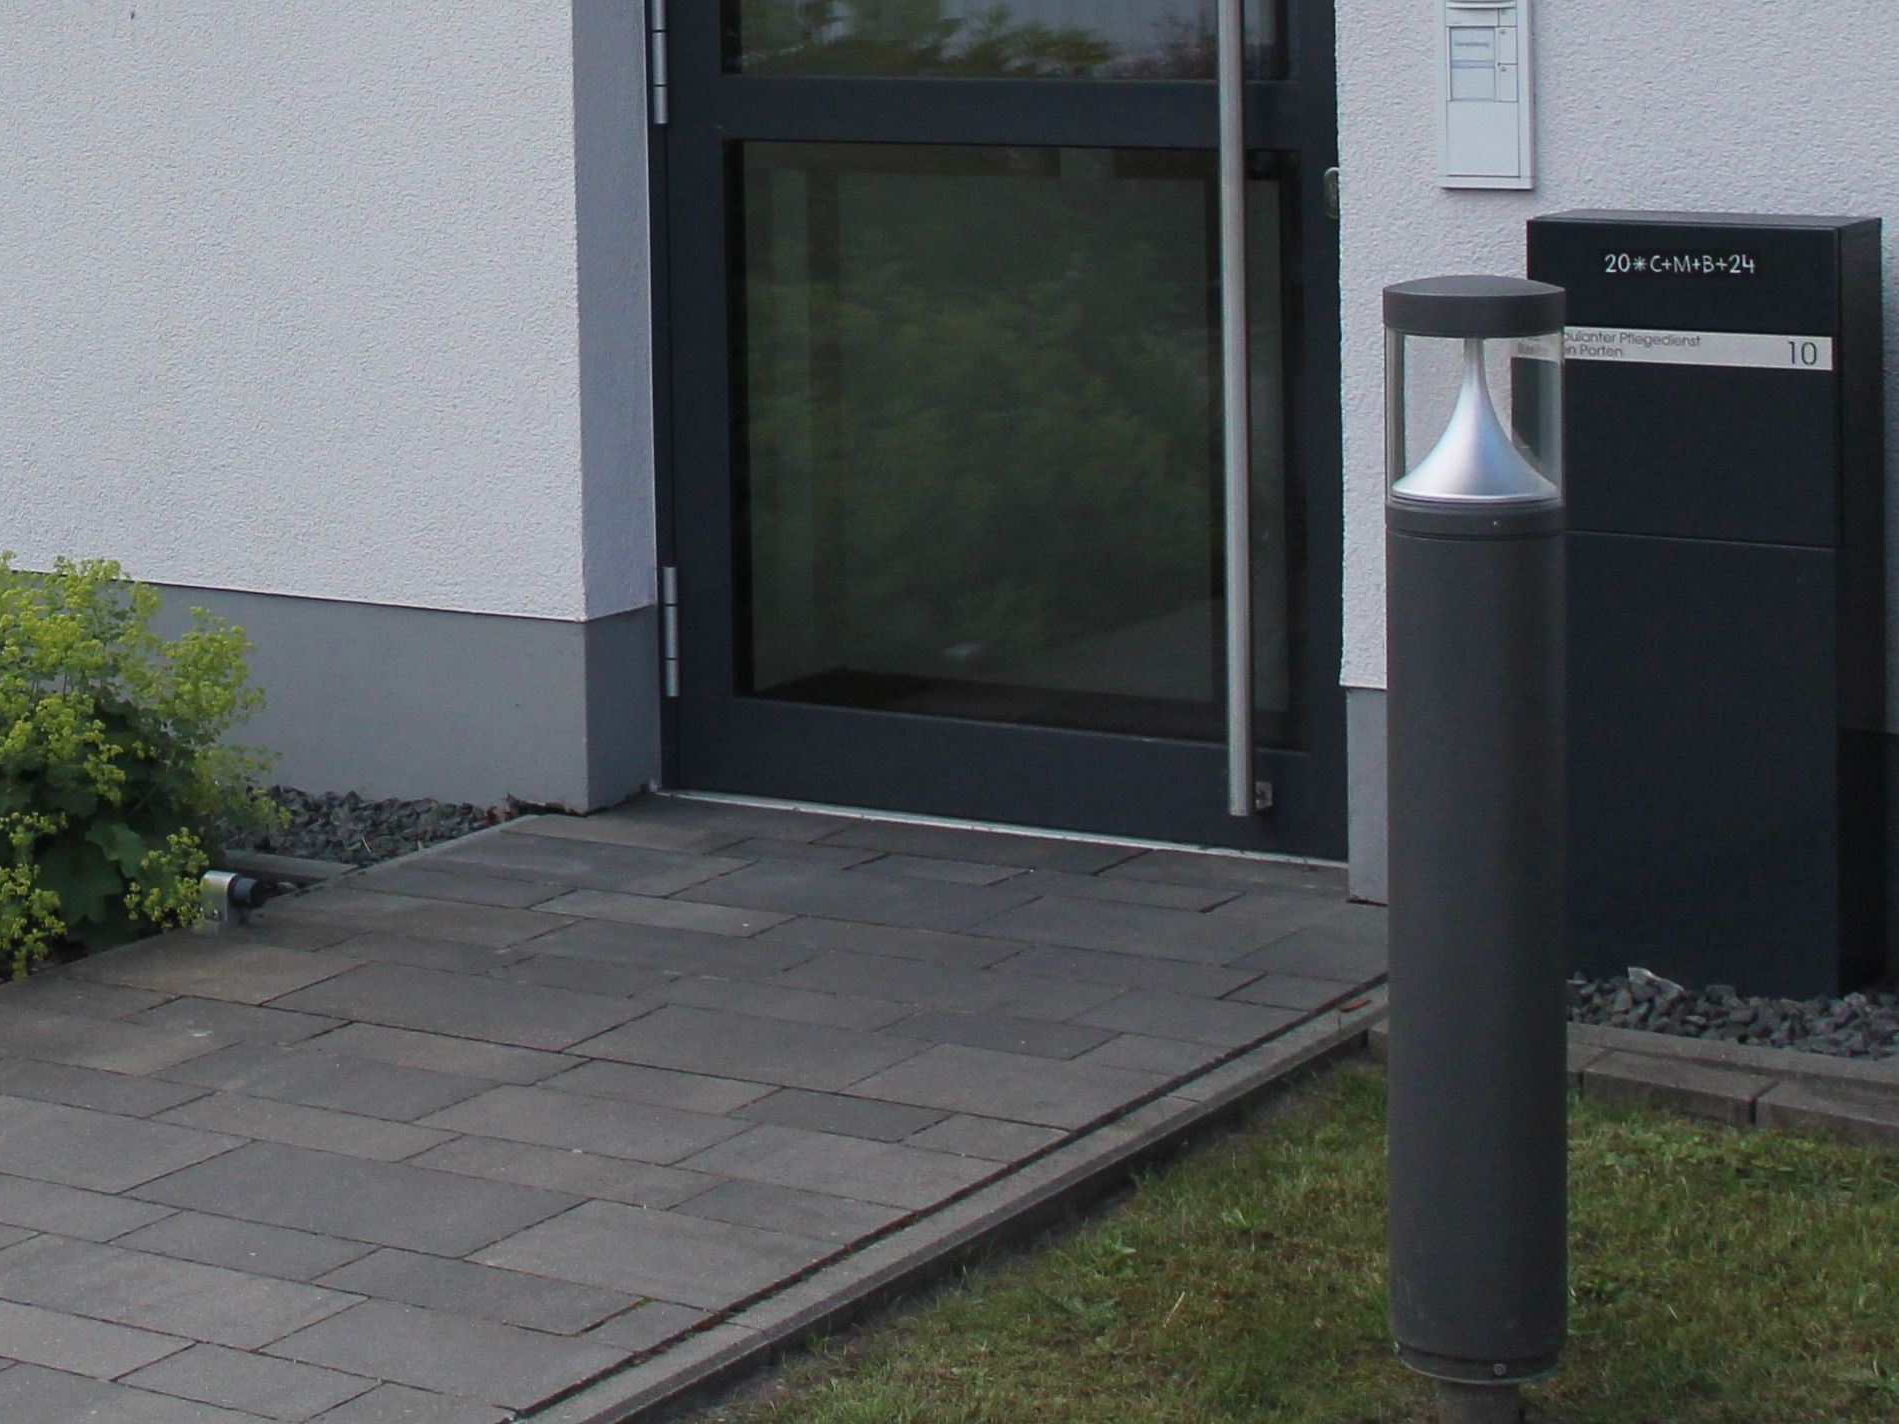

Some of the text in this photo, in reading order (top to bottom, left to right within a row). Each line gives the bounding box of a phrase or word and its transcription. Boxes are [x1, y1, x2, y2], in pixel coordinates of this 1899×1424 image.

[1619, 332, 1702, 348] Pflegedienst
[1580, 344, 1623, 358] Porten
[1786, 340, 1818, 366] 10
